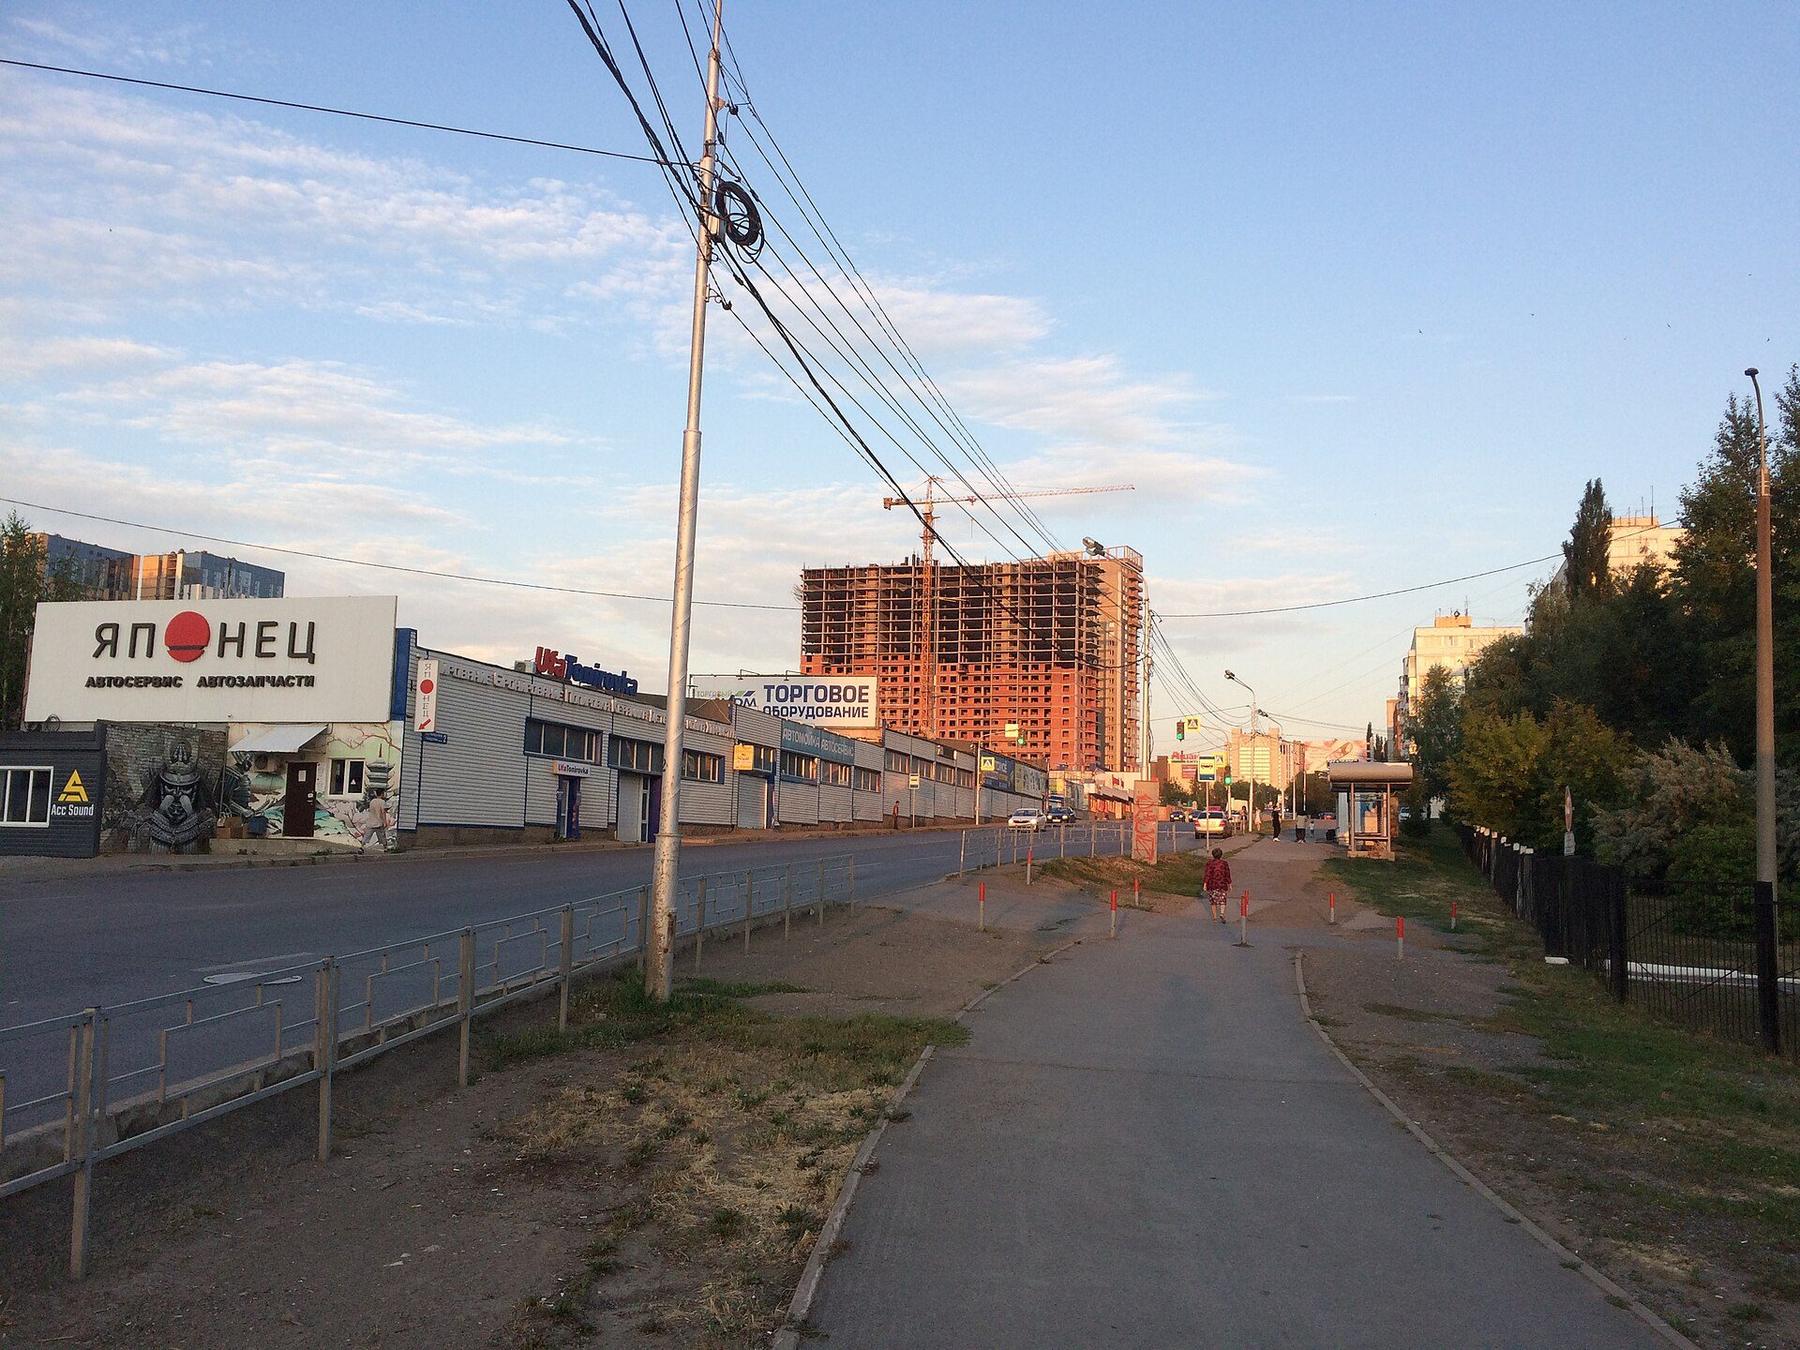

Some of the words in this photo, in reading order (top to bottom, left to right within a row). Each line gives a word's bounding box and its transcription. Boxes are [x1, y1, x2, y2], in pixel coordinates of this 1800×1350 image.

[92, 610, 316, 664] ЯПОНЕЦ
[85, 675, 183, 688] АВТОСЕРВИС
[197, 674, 315, 688] АВТОЗАПЧАСТИ
[764, 685, 869, 702] ТОРГОВОЕ
[763, 706, 868, 720] ОБОРУДОВАНИЕ
[783, 726, 820, 748] АВТОМОЙКА
[820, 735, 854, 757] АВТОСЕРВИС
[51, 804, 67, 816] Acc
[68, 804, 94, 816] Sound
